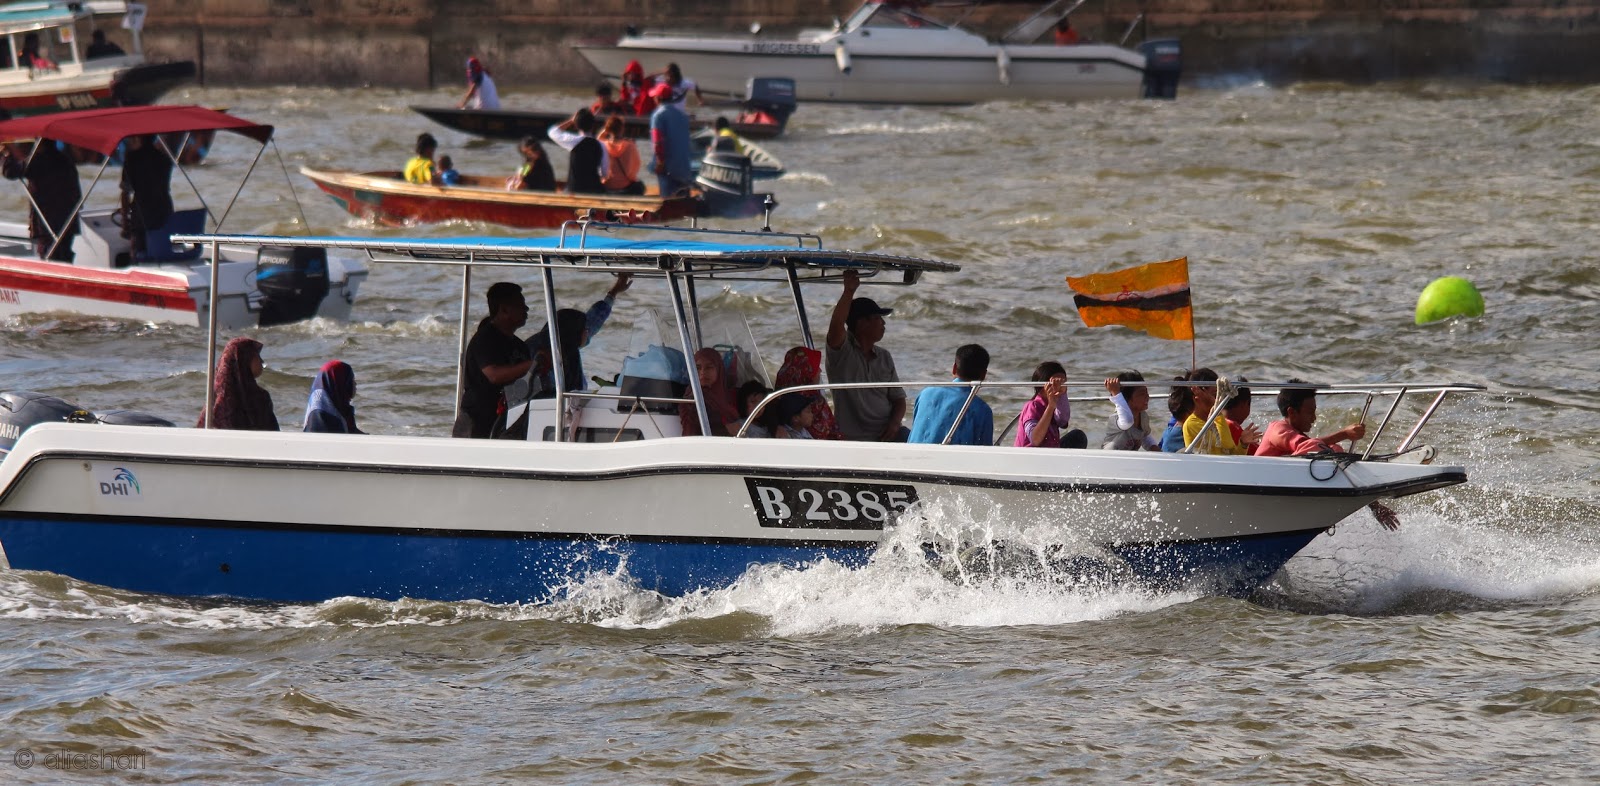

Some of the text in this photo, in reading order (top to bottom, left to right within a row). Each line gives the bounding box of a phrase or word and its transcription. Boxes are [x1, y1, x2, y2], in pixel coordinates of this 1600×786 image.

[752, 43, 821, 54] IMIGRESEN
[259, 256, 290, 265] MERCURY
[0, 422, 20, 440] AHA
[99, 482, 129, 496] DHI
[756, 486, 913, 522] B 2385
